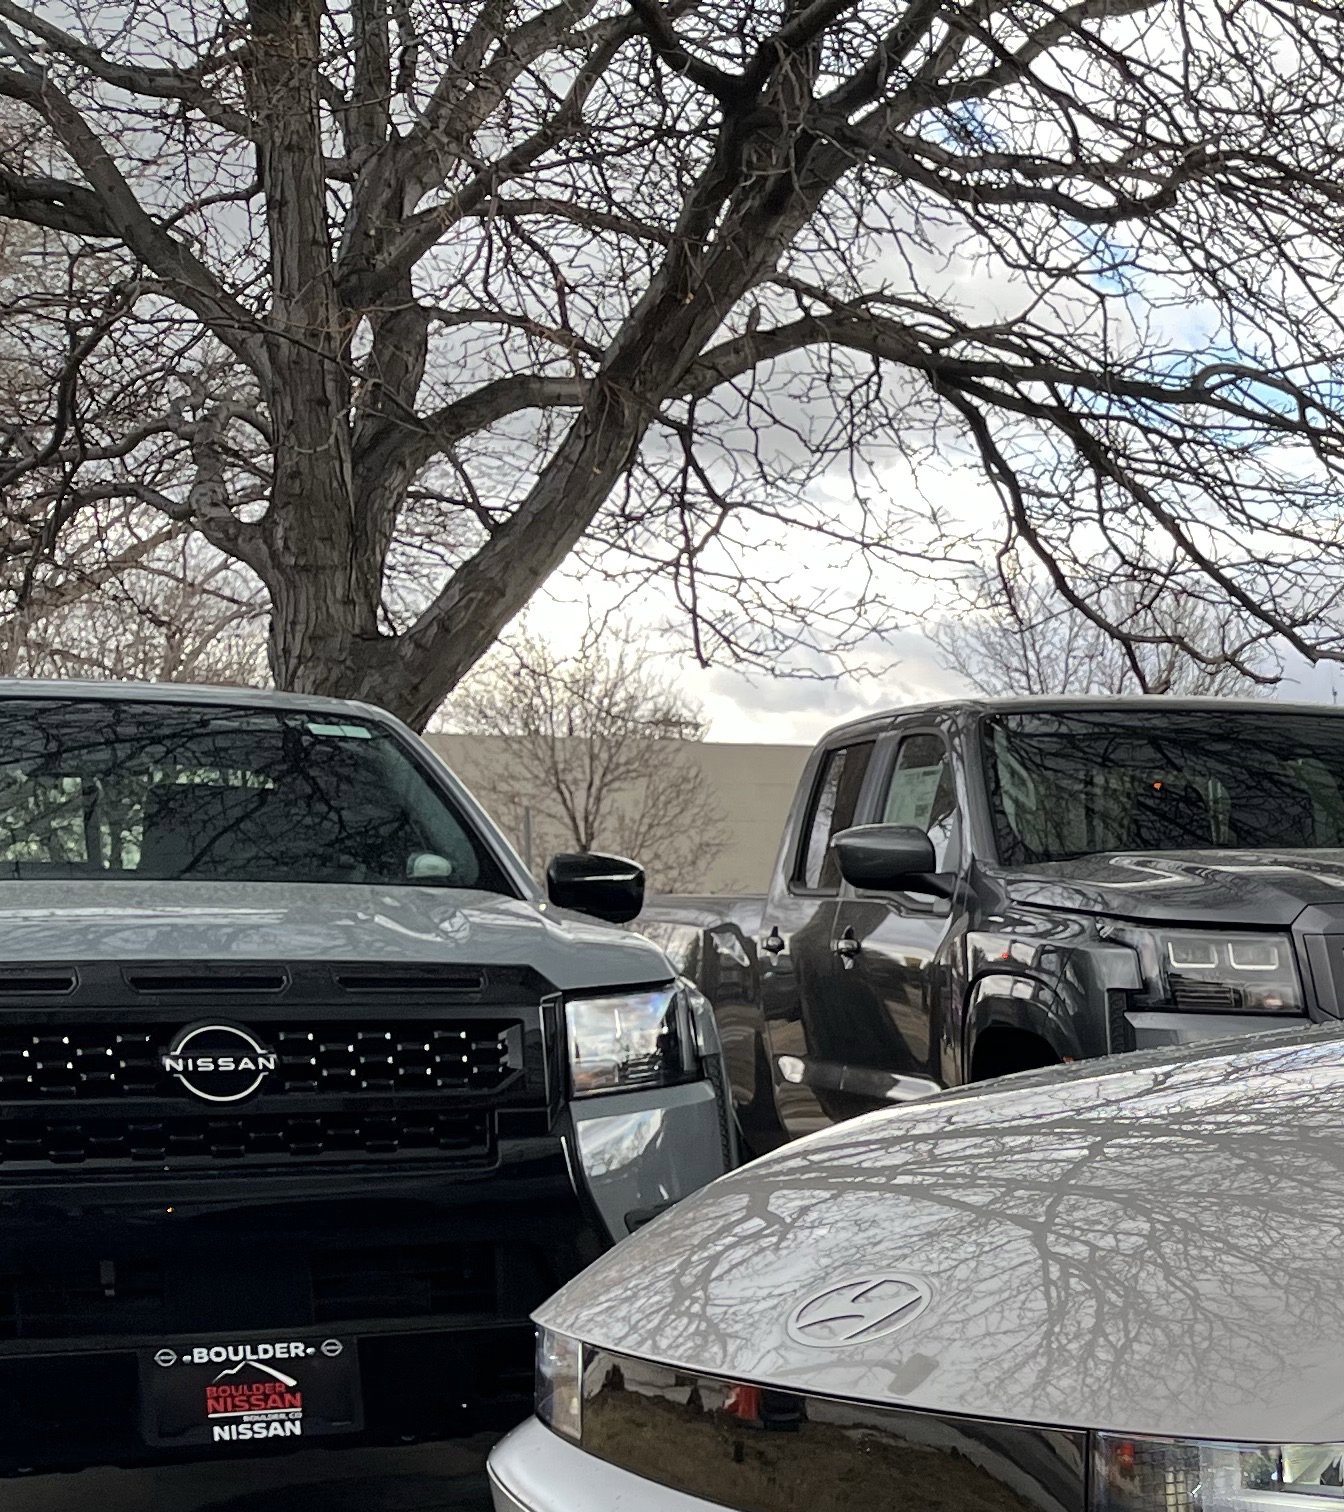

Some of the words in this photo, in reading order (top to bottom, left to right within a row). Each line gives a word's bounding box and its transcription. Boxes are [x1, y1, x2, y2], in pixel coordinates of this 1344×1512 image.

[165, 1056, 275, 1072] NISSAN
[192, 1342, 306, 1364] BOULDER
[206, 1382, 286, 1399] BOULDER
[207, 1392, 302, 1414] NISSAN
[212, 1420, 302, 1442] NISSAN
